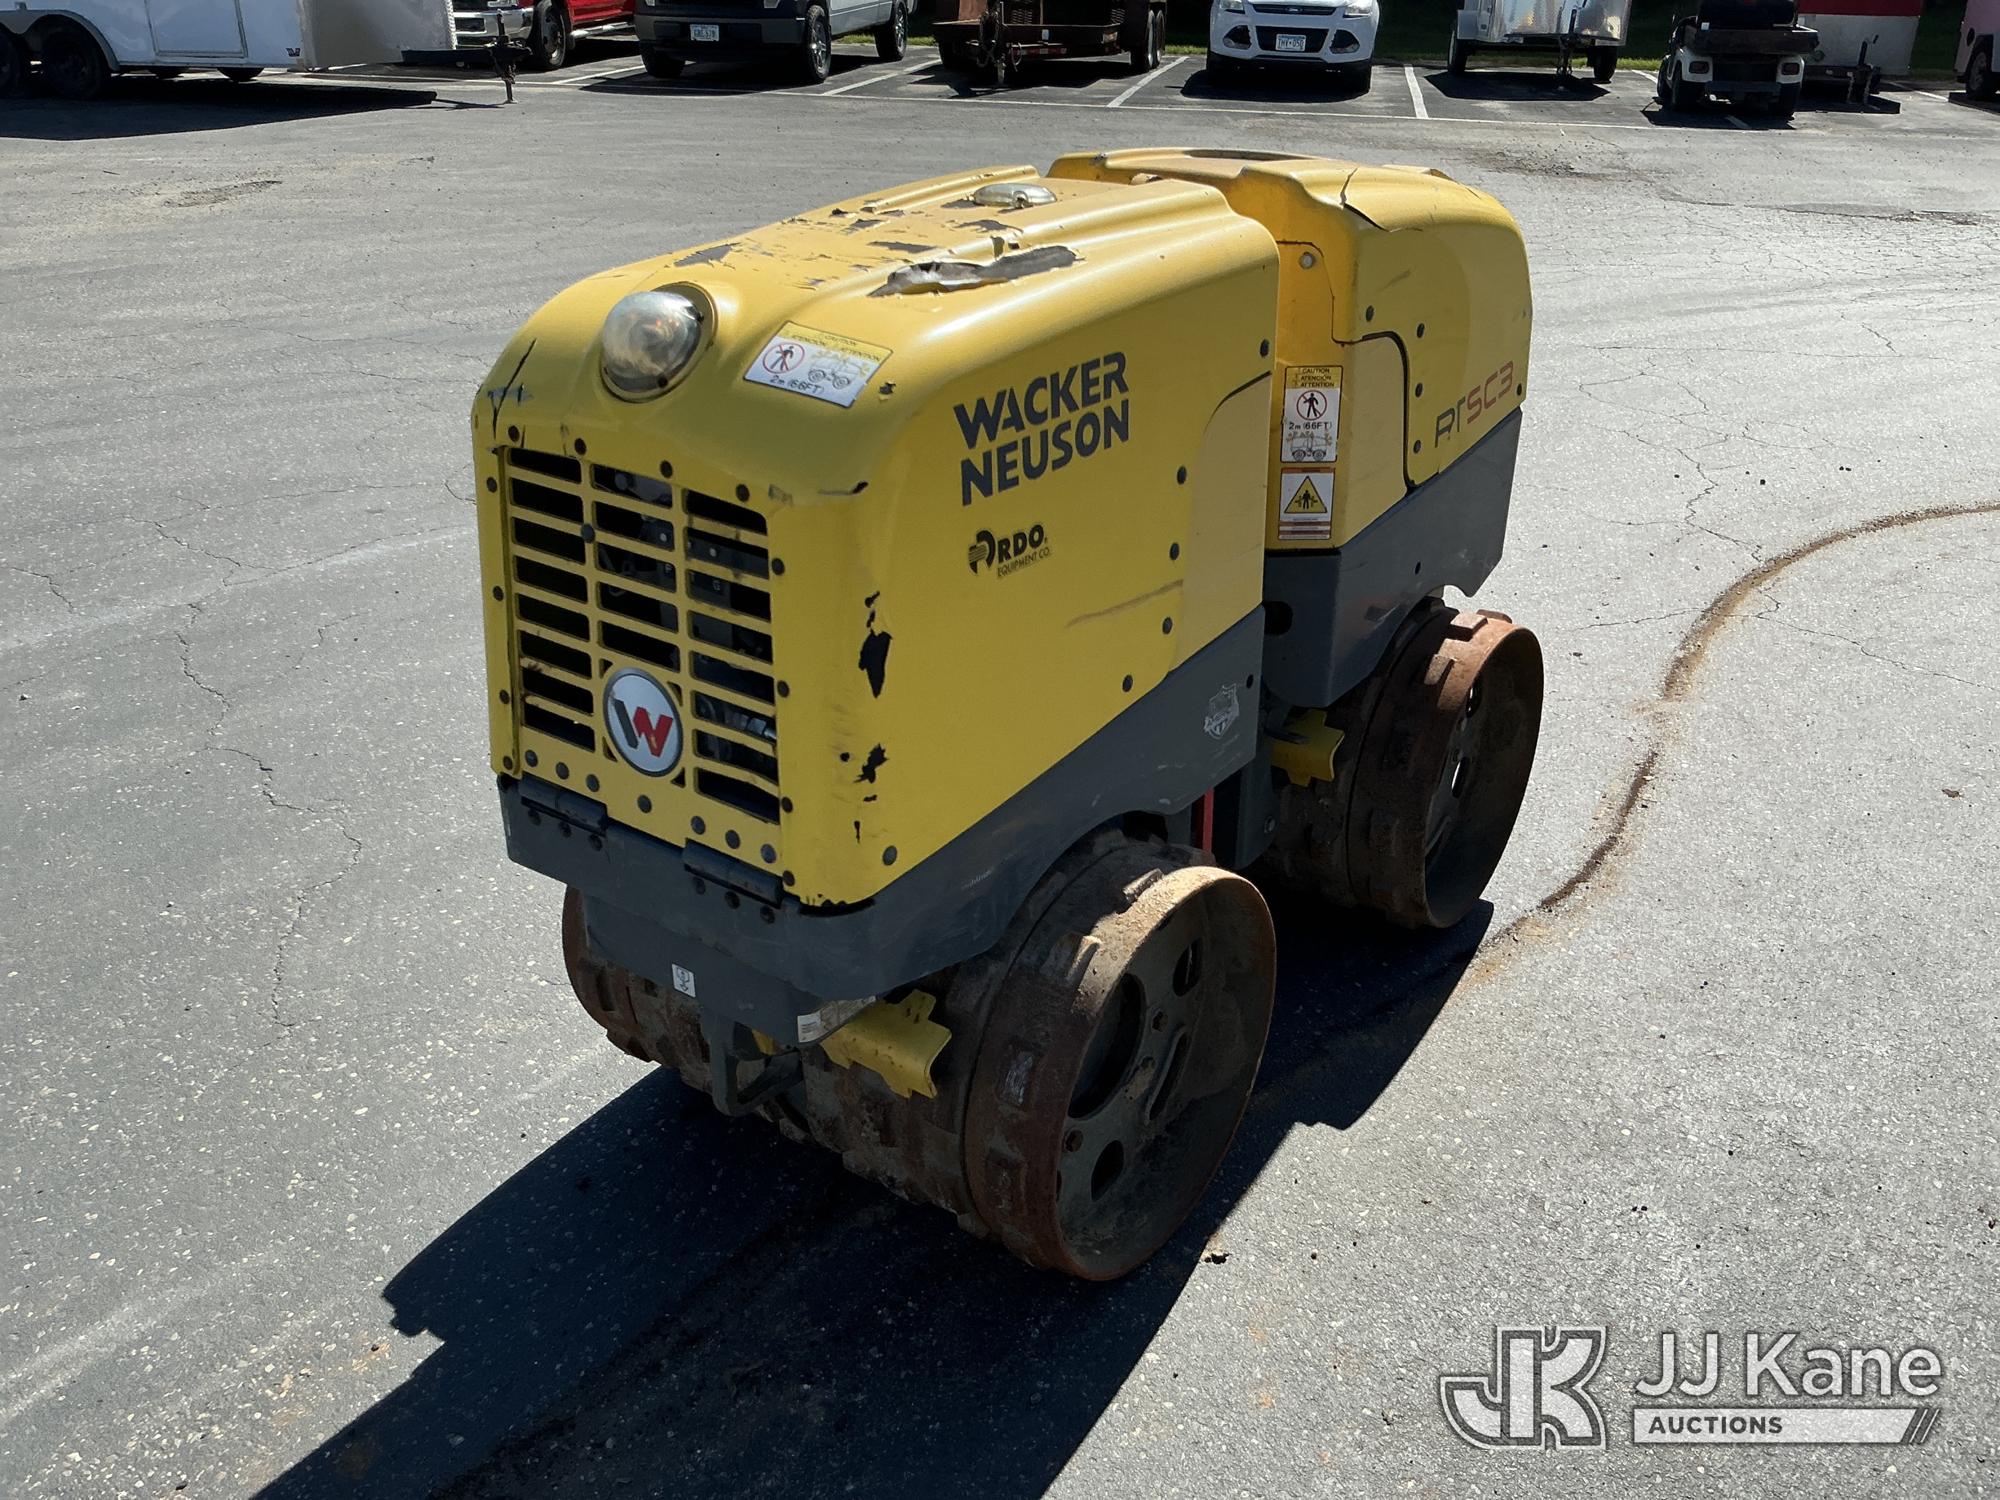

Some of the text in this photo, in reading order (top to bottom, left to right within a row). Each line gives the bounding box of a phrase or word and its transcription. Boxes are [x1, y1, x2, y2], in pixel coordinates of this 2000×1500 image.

[953, 351, 1130, 450] WACKER
[1302, 366, 1331, 374] CAUTION
[960, 399, 1130, 507] NEUSON
[997, 551, 1038, 577] EQUIPMENT
